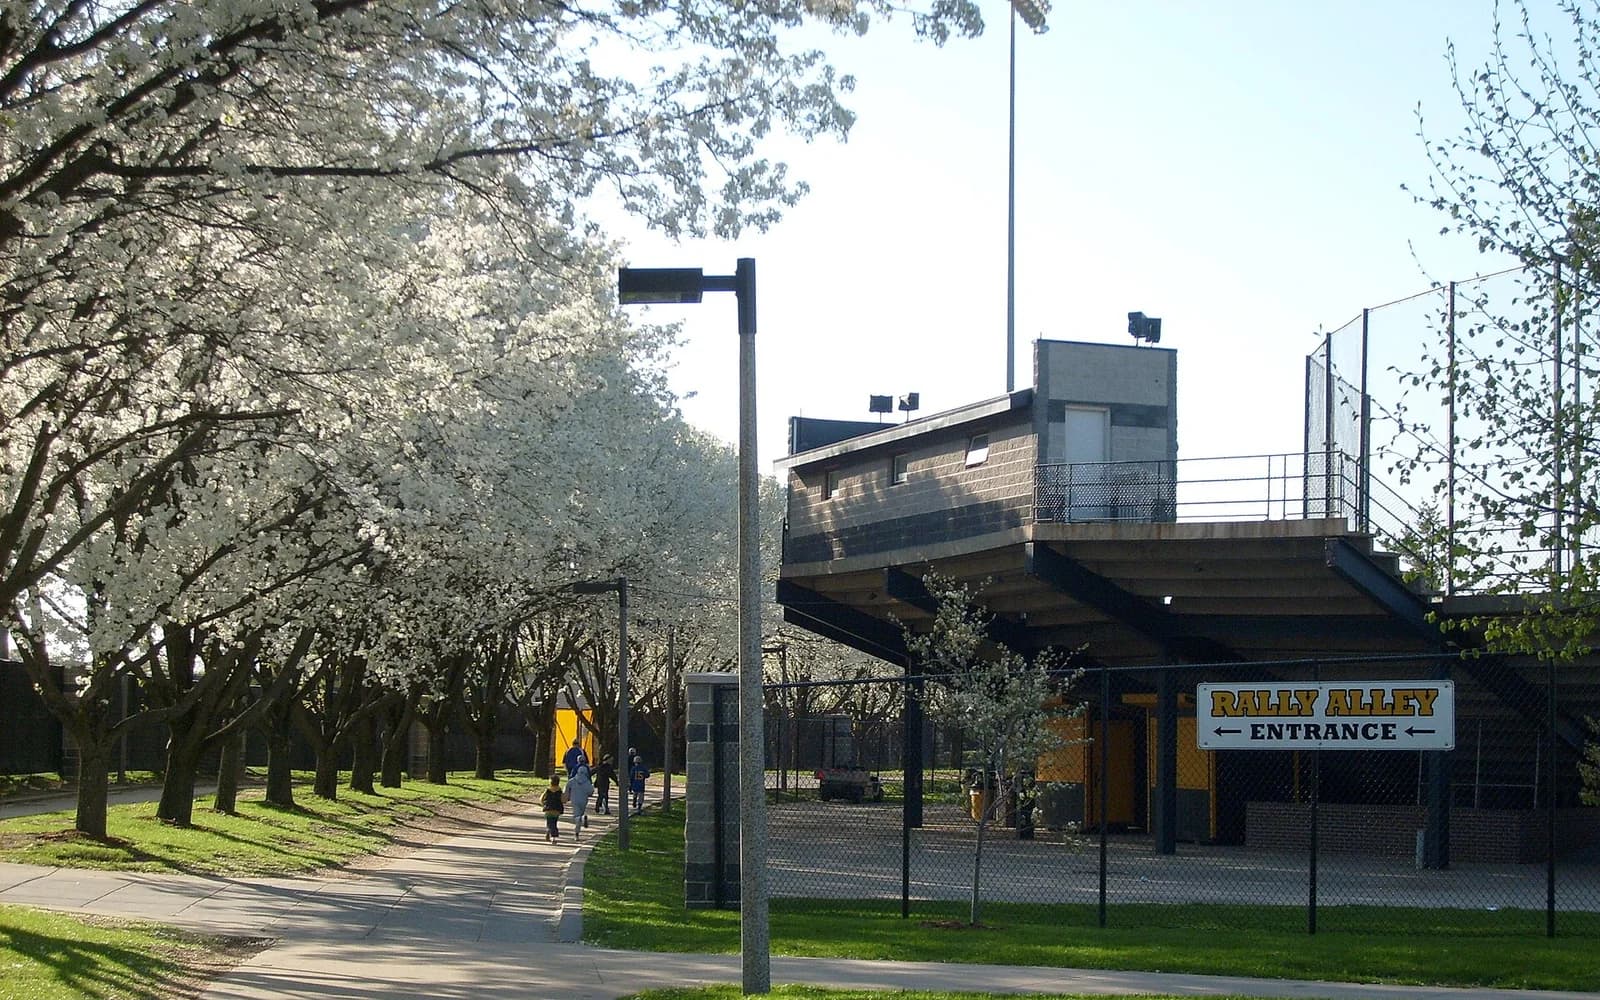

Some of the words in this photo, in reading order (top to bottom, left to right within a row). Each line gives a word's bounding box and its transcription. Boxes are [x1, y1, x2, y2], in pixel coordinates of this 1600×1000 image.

[1211, 690, 1319, 717] RALLY
[1325, 689, 1439, 716] ALLEY
[1250, 723, 1397, 740] ENTRANCE
